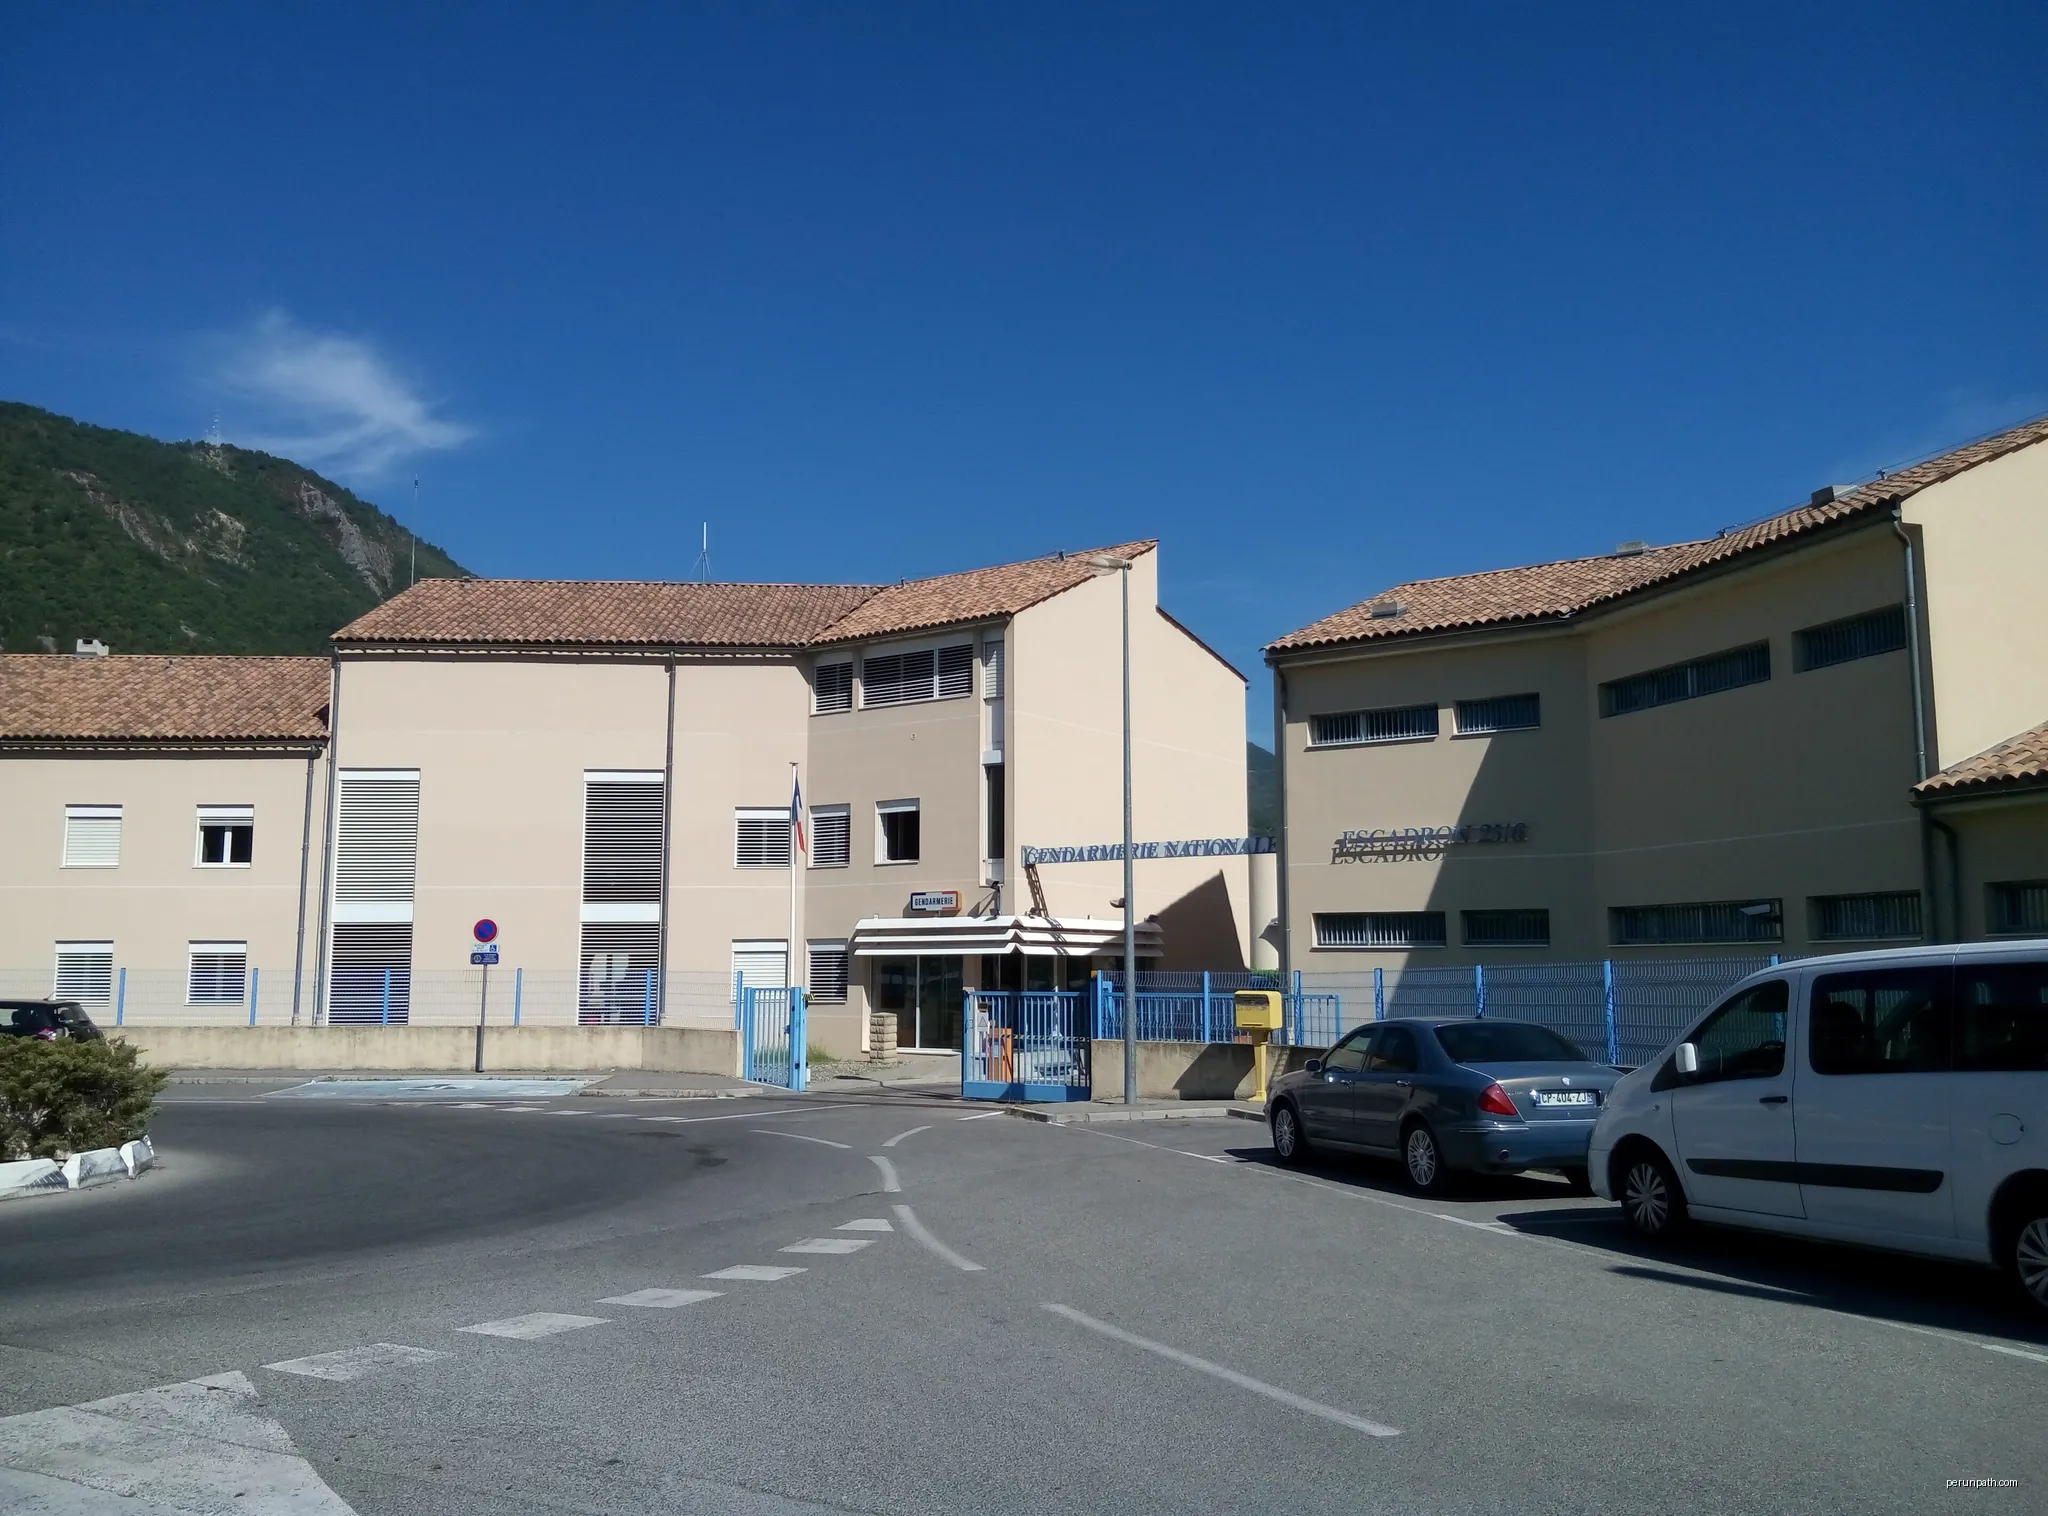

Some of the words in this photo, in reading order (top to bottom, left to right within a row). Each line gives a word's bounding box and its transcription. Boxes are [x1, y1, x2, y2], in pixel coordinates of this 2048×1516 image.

[1341, 825, 1471, 849] ESCADRON
[1026, 841, 1160, 865] GENDARMERIE
[1163, 836, 1277, 859] NATIONALE
[914, 896, 954, 906] GENDARMERIE
[1541, 1091, 1587, 1104] CP-404-ZJ
